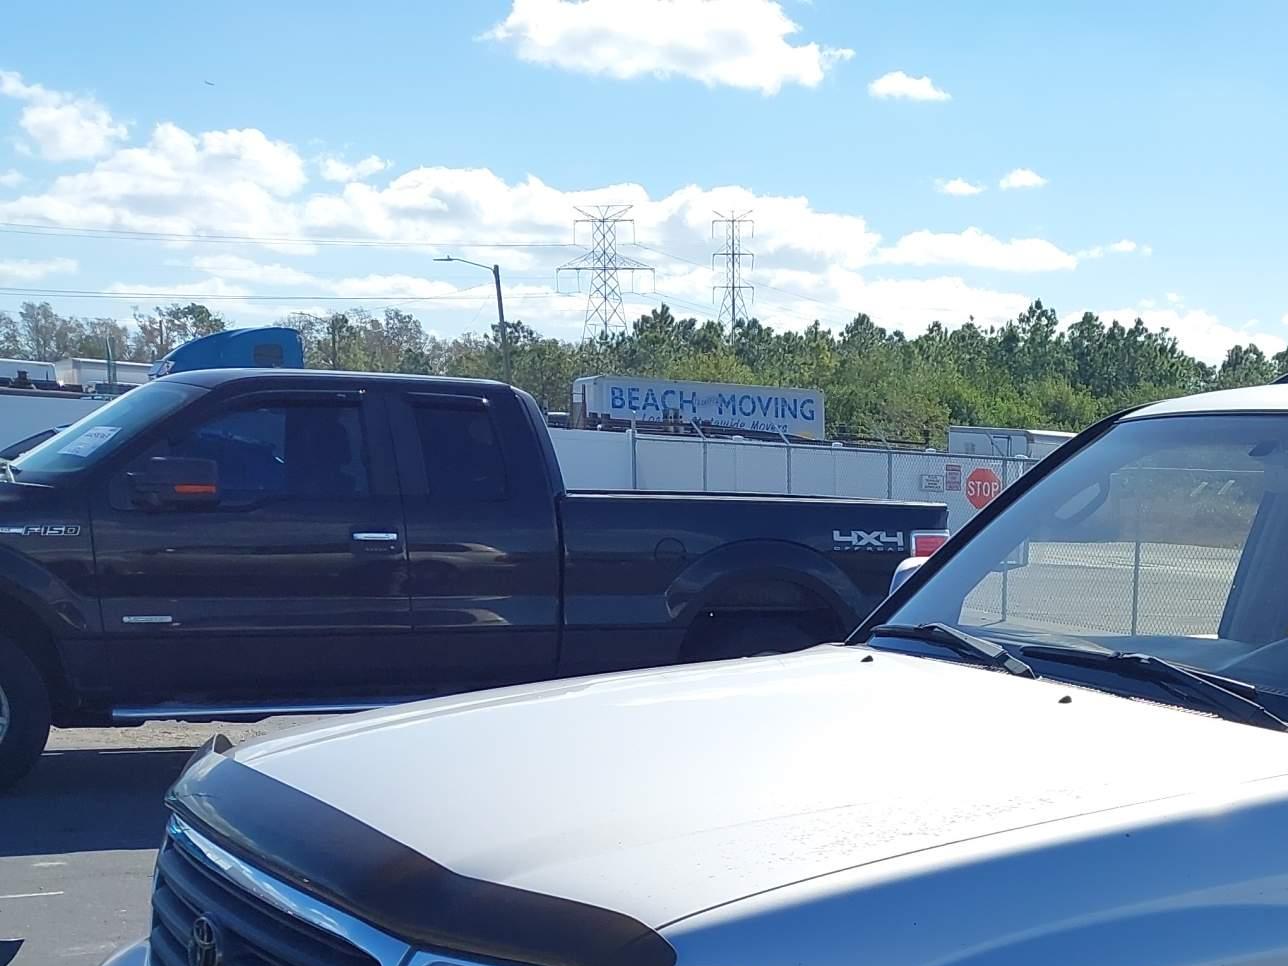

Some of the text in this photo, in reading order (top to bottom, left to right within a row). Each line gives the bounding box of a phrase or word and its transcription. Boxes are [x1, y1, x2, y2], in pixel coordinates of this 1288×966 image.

[611, 386, 697, 414] BEACH
[718, 392, 815, 421] MOVING
[967, 480, 1000, 498] STOP
